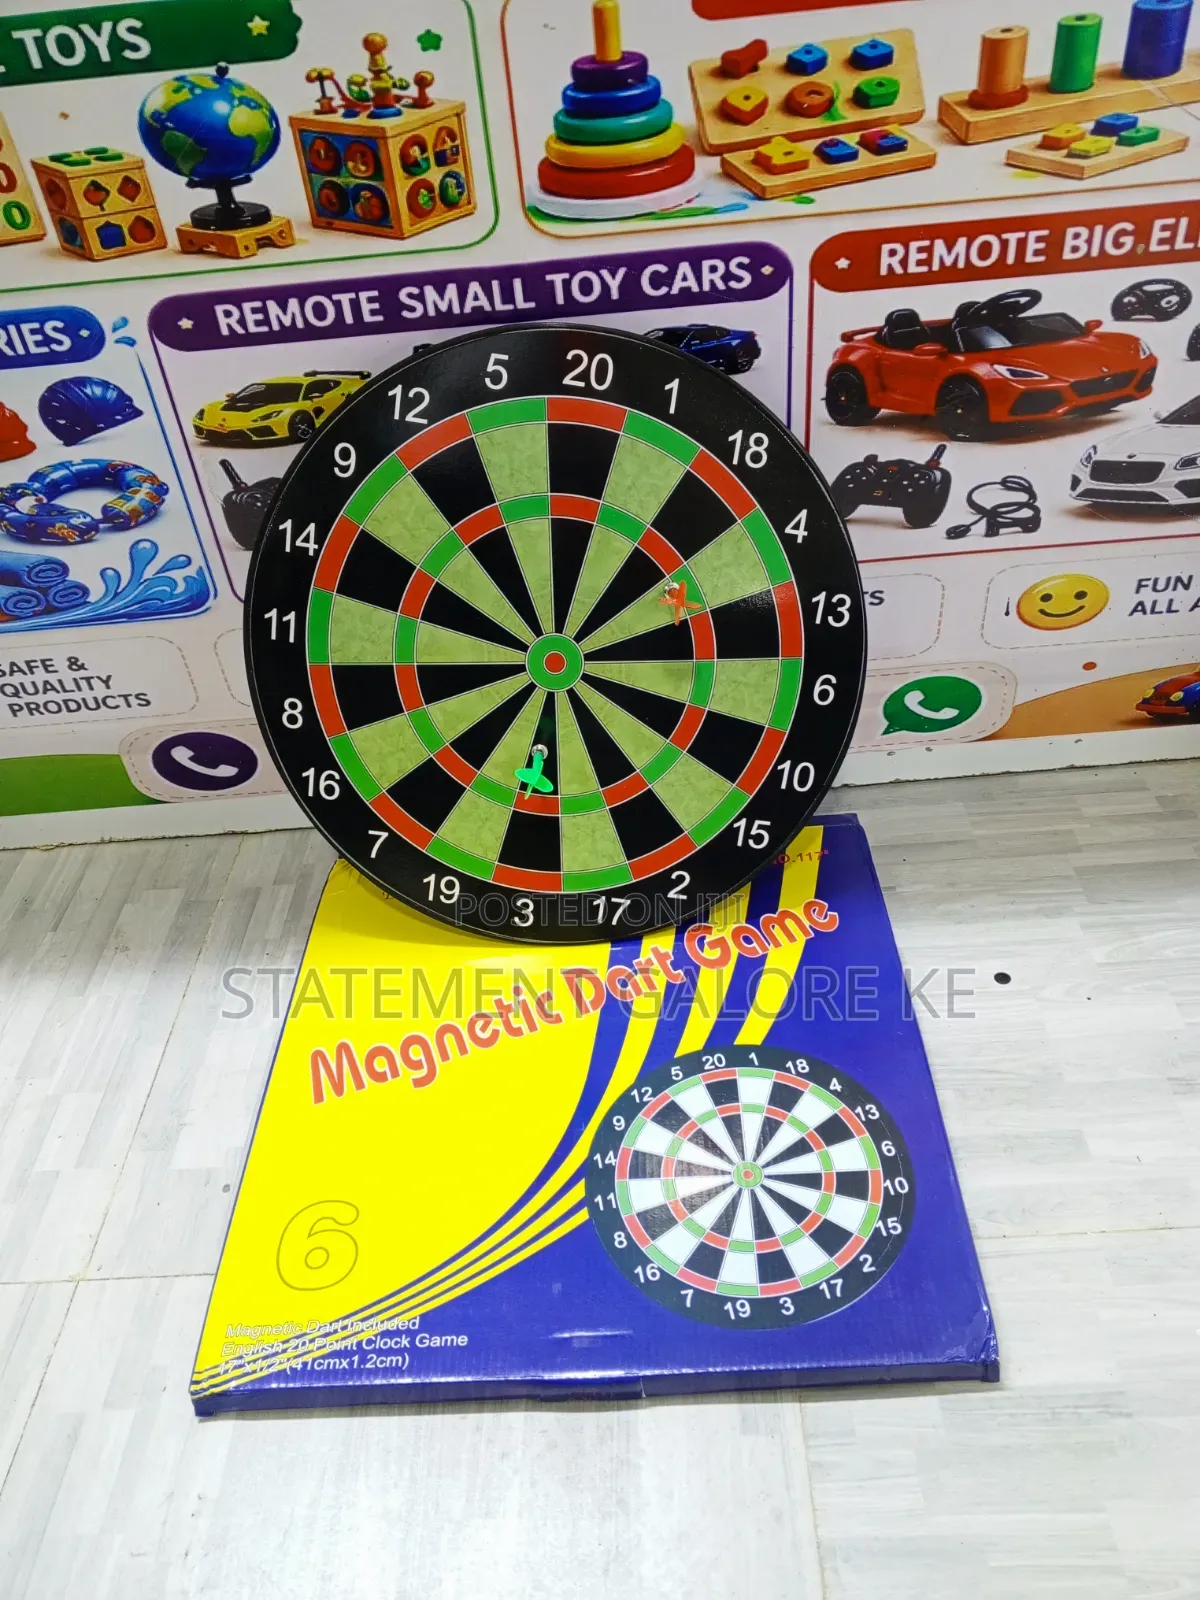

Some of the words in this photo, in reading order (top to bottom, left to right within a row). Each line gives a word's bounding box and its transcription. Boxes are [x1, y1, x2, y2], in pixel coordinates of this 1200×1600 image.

[11, 18, 151, 70] TOYS
[879, 230, 1050, 276] REMOTE
[1062, 222, 1136, 260] BIG
[1149, 216, 1200, 252] EL
[214, 290, 384, 336] REMOTE
[398, 279, 536, 319] SMALL
[545, 267, 627, 305] TOY
[640, 256, 752, 296] CARS
[485, 353, 508, 389] 5
[563, 350, 613, 390] 20
[388, 385, 429, 424] 12
[665, 379, 679, 414] 1
[334, 443, 356, 477] 9
[729, 430, 768, 468] 18
[279, 519, 318, 556] 14
[785, 509, 807, 543] 4
[1134, 574, 1194, 594] FUN
[812, 592, 850, 627] 13
[1128, 598, 1180, 617] ALL
[265, 609, 295, 642] 11
[66, 656, 89, 672] &
[0, 674, 113, 699] QUALITY
[814, 675, 836, 705] 6
[7, 692, 151, 718] PRODUCTS
[282, 698, 302, 728] 8
[302, 768, 340, 800] 16
[778, 760, 814, 791] 10
[369, 830, 388, 858] 7
[734, 818, 770, 849] 15
[423, 874, 459, 903] 19
[667, 871, 690, 899] 2
[514, 898, 533, 926] 3
[593, 896, 630, 925] 17
[310, 985, 564, 1105] Magnetic
[561, 946, 686, 1016] Dart
[684, 899, 839, 970] Game
[702, 1054, 725, 1070] 20
[749, 1053, 758, 1065] 1
[786, 1059, 809, 1074] 18
[671, 1066, 683, 1080] 5
[830, 1078, 842, 1091] 4
[631, 1086, 653, 1103] 12
[613, 1116, 625, 1130] 9
[855, 1104, 879, 1121] 13
[594, 1150, 616, 1169] 14
[882, 1141, 895, 1156] 6
[883, 1177, 908, 1195] 10
[595, 1193, 616, 1210] 11
[876, 1217, 902, 1236] 15
[276, 1199, 360, 1291] 6
[614, 1231, 627, 1248] 8
[634, 1263, 660, 1284] 16
[860, 1254, 875, 1272] 2
[681, 1289, 693, 1307] 7
[820, 1279, 842, 1299] 17
[724, 1300, 750, 1319] 19
[780, 1297, 794, 1315] 3
[225, 1321, 303, 1340] Magnetic
[306, 1319, 342, 1334] Dart
[347, 1316, 420, 1333] Included
[221, 1340, 283, 1358] English
[287, 1338, 309, 1353] 20
[313, 1336, 358, 1352] Point
[362, 1334, 411, 1350] Clock
[415, 1333, 468, 1348] Game
